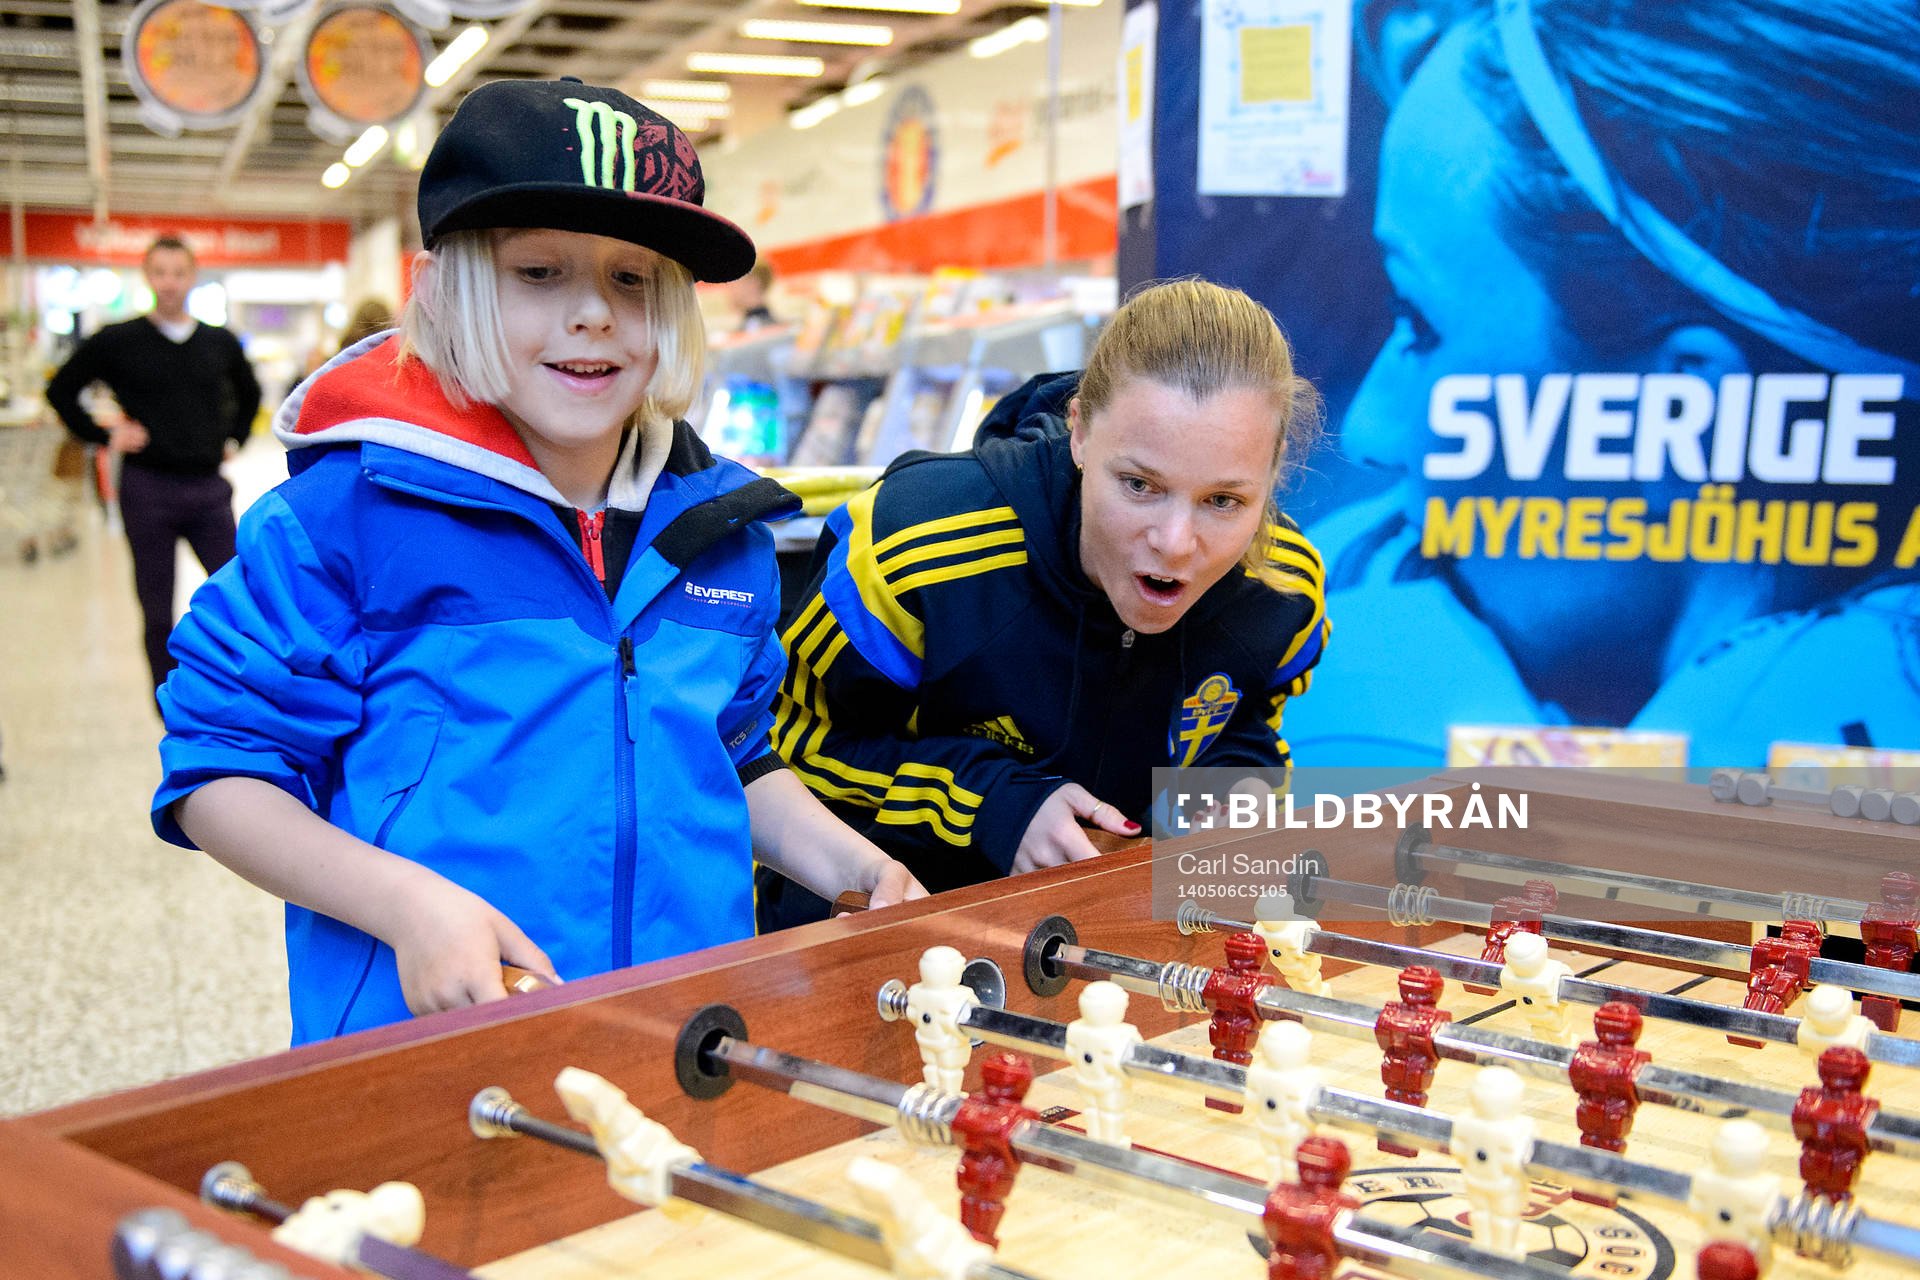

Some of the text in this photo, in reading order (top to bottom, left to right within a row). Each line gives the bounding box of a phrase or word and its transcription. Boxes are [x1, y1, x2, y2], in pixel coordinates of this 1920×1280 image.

[1423, 373, 1904, 485] SVERIGE
[1421, 484, 1879, 567] MYRESJÖHUS
[693, 584, 755, 603] EVEREST
[729, 731, 747, 749] TCS
